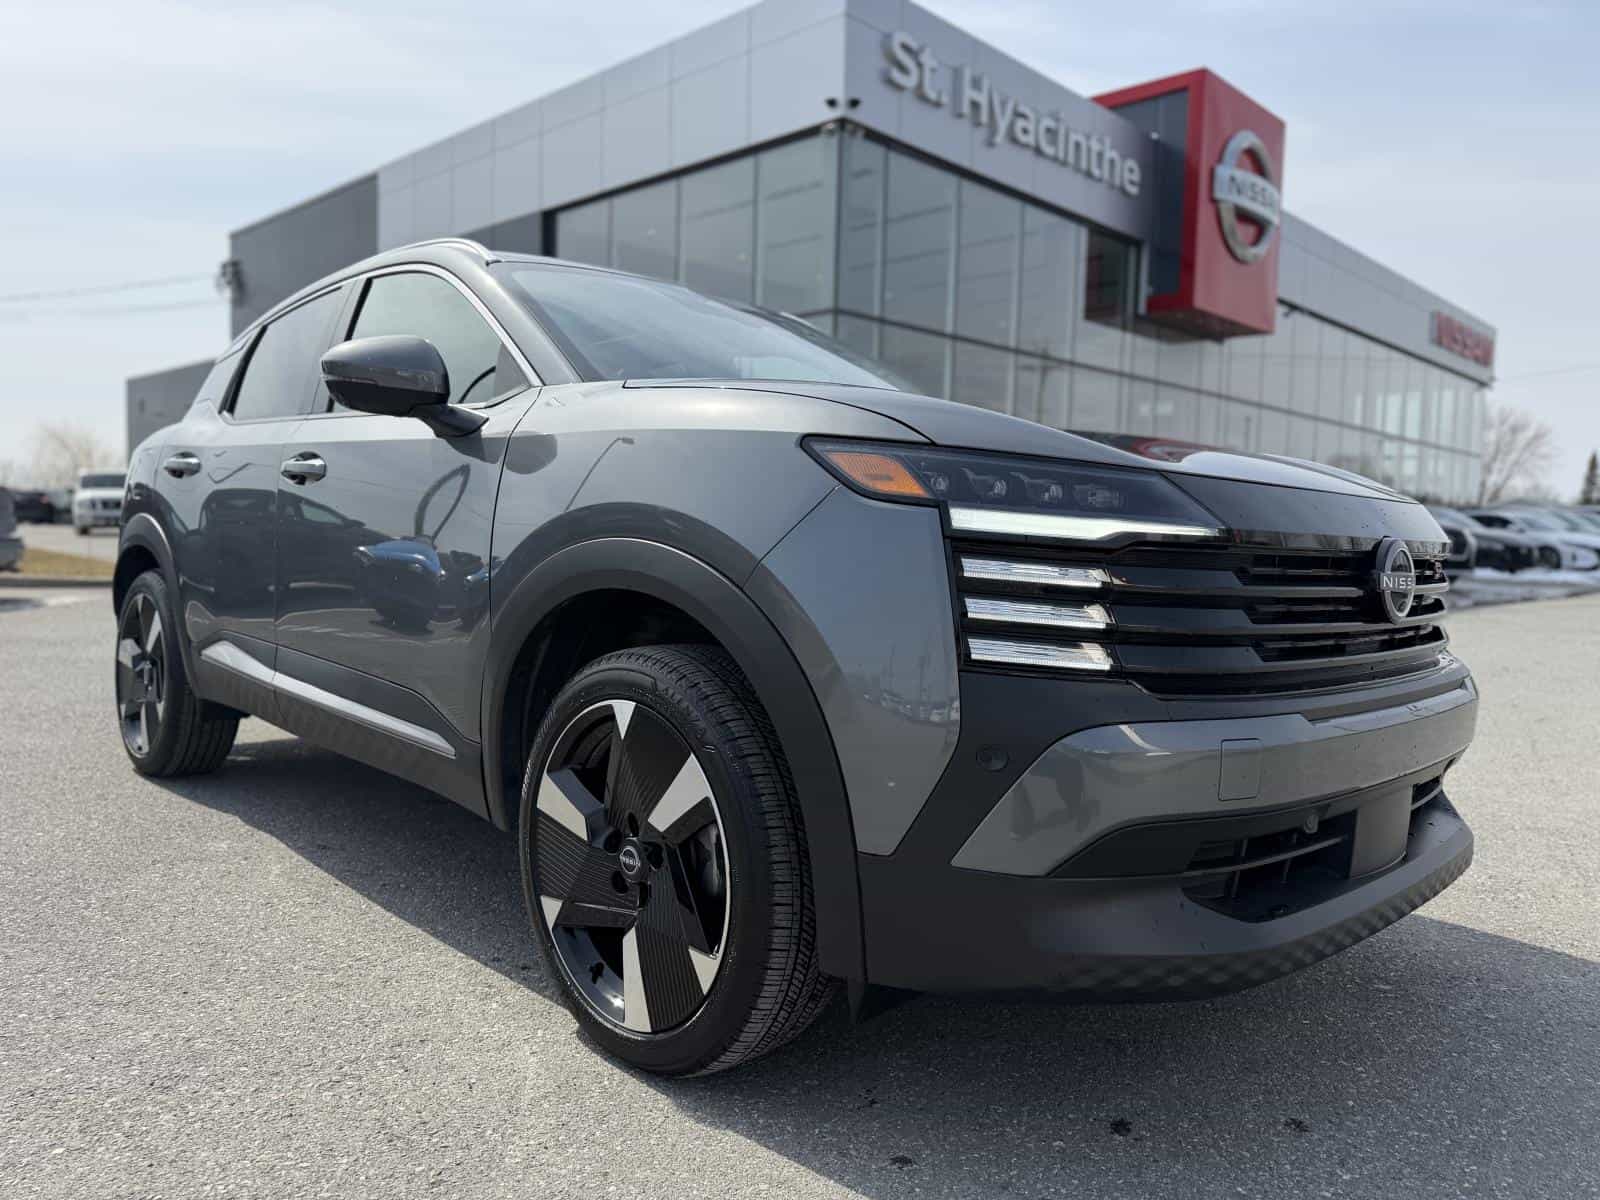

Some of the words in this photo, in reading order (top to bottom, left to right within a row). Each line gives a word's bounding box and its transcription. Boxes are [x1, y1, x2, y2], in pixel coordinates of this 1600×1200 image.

[888, 31, 948, 106] St.
[961, 66, 1141, 196] Hyacinthe
[1383, 575, 1415, 589] NISS
